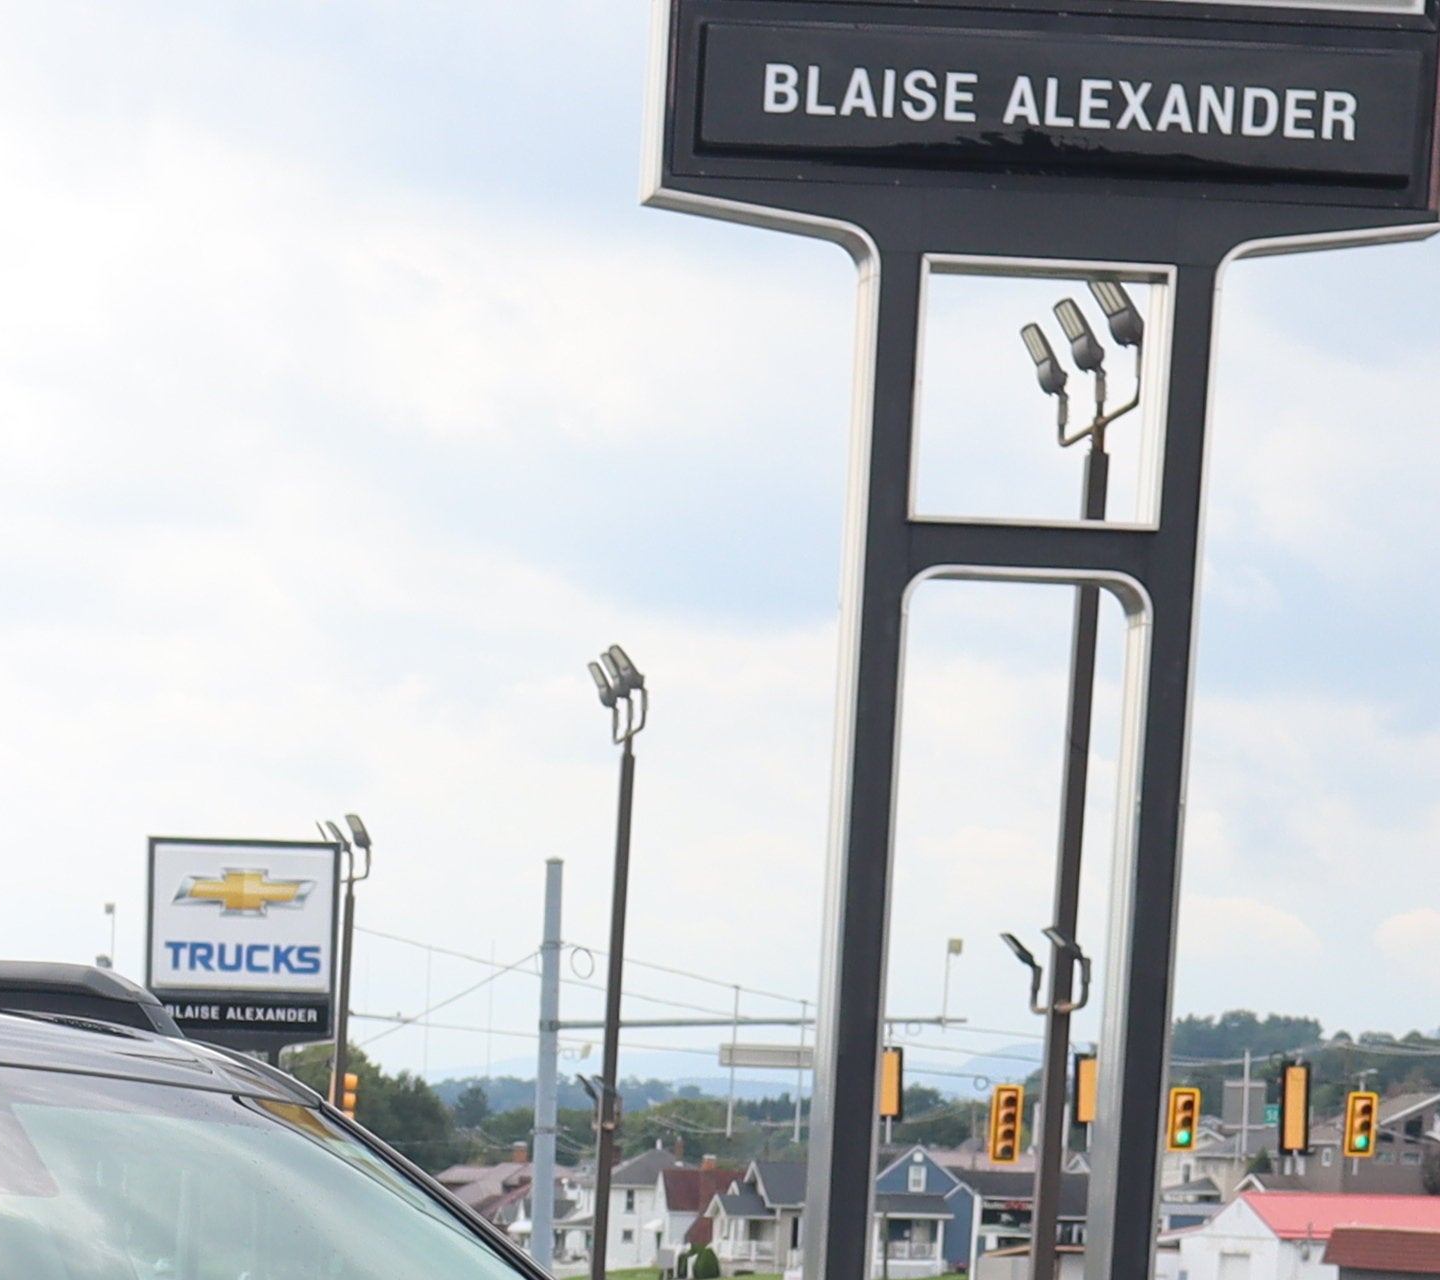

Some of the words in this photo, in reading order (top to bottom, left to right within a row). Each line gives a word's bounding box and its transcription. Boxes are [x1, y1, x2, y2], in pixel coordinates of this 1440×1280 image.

[763, 64, 978, 123] BLAISE
[1003, 75, 1357, 141] ALEXANDER
[164, 941, 322, 975] TRUCKS
[226, 1005, 318, 1023] ALEXANDER
